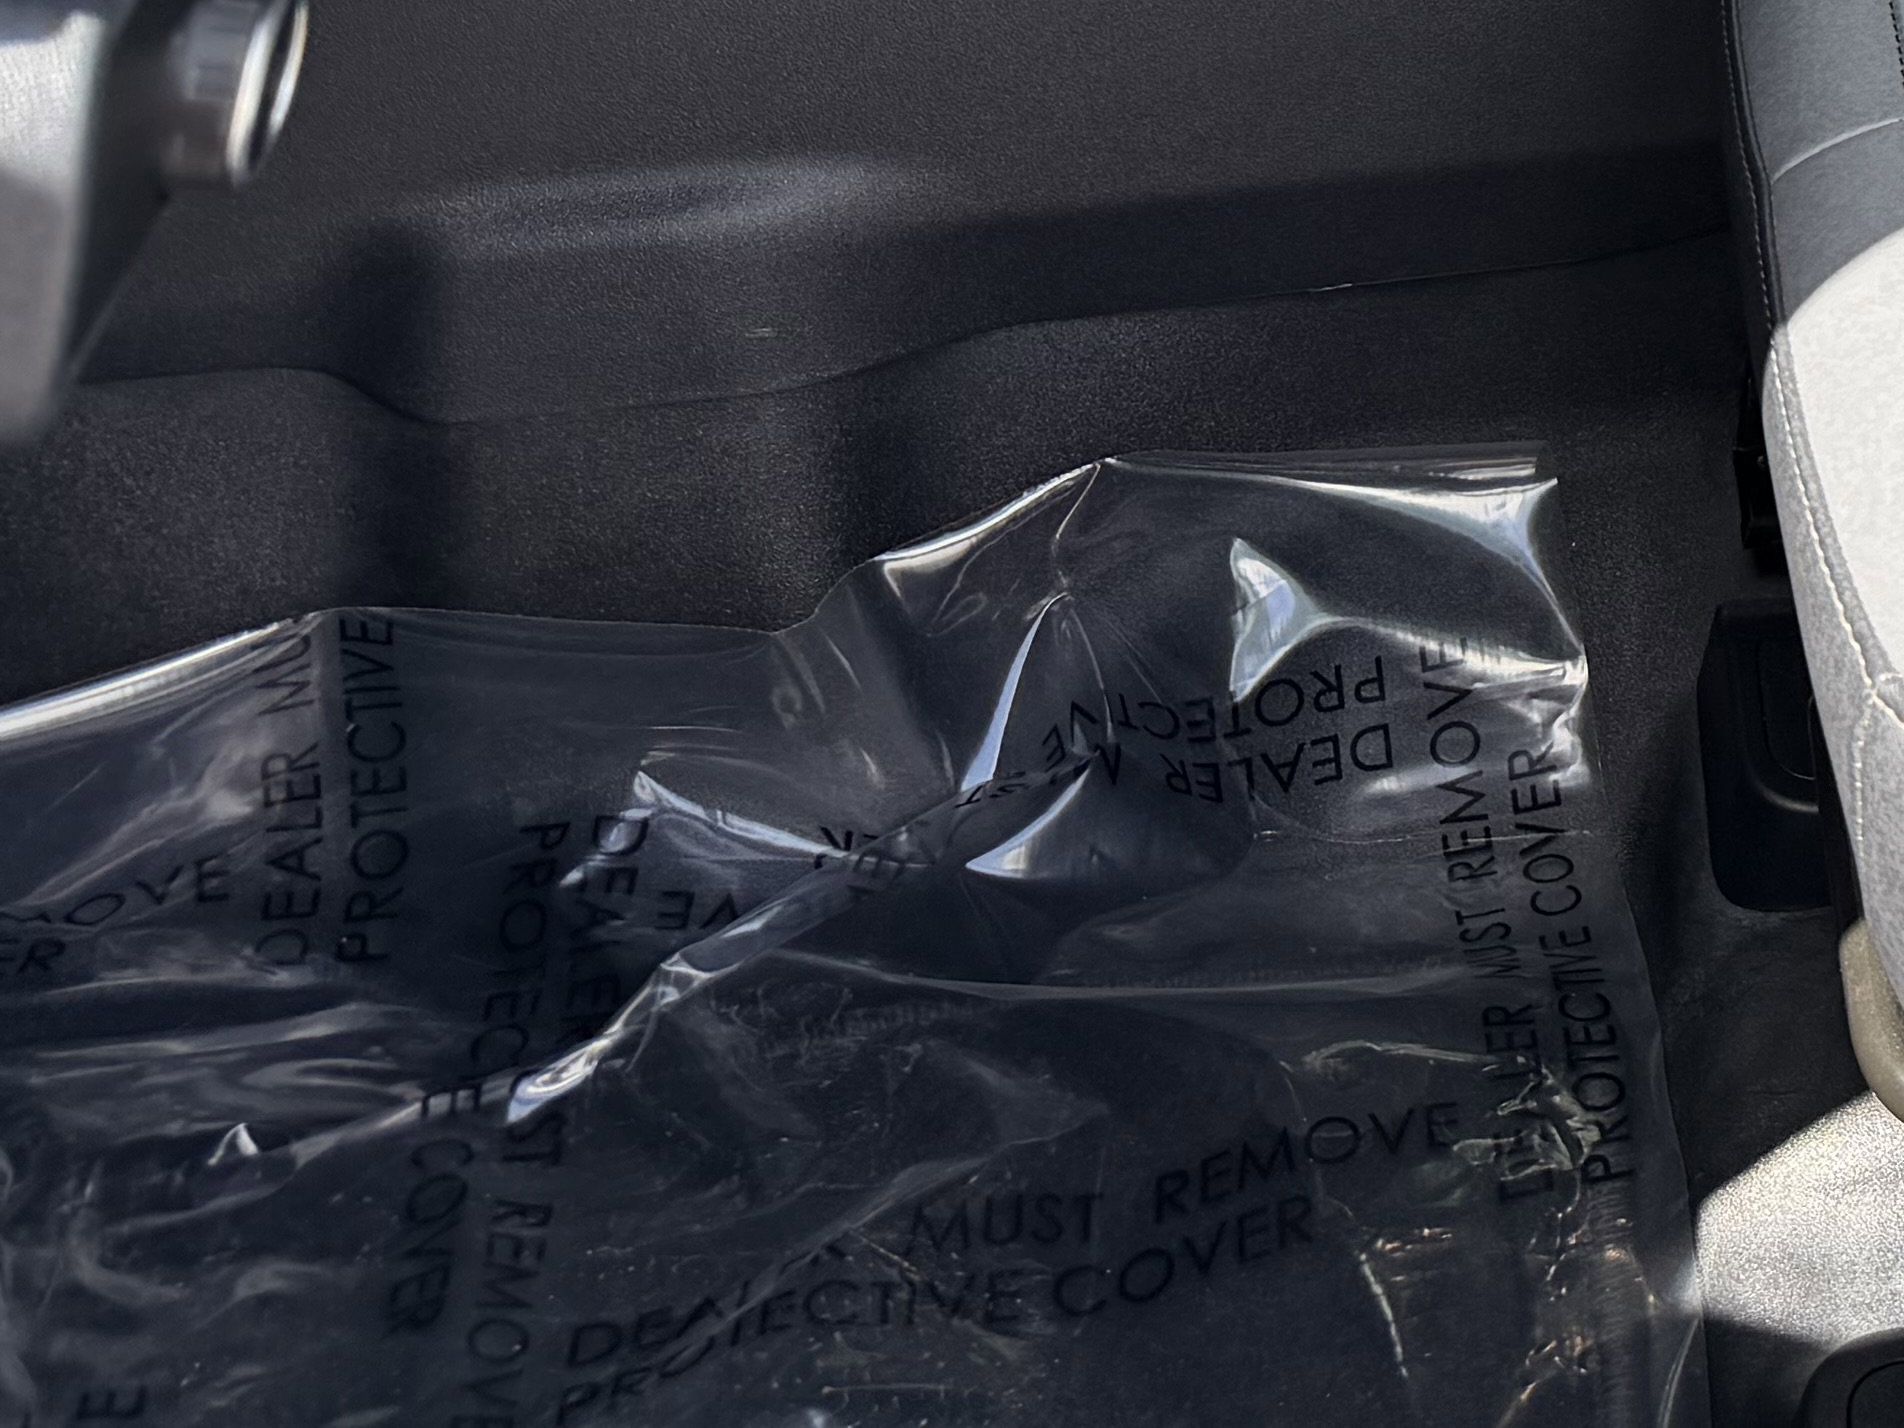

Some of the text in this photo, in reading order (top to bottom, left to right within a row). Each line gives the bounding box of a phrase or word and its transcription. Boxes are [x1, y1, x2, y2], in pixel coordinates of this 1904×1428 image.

[253, 741, 323, 967] DEALER
[333, 616, 409, 966] PROTECTIVE
[1164, 722, 1393, 803] DEALER
[1420, 638, 1498, 886] REMOVE
[1455, 906, 1521, 980] MUST
[1507, 748, 1637, 1186] PROTECTIVE COVER
[907, 1191, 1105, 1257] MUST
[1152, 1100, 1460, 1224] REMOVE
[1050, 1193, 1315, 1319] COVER
